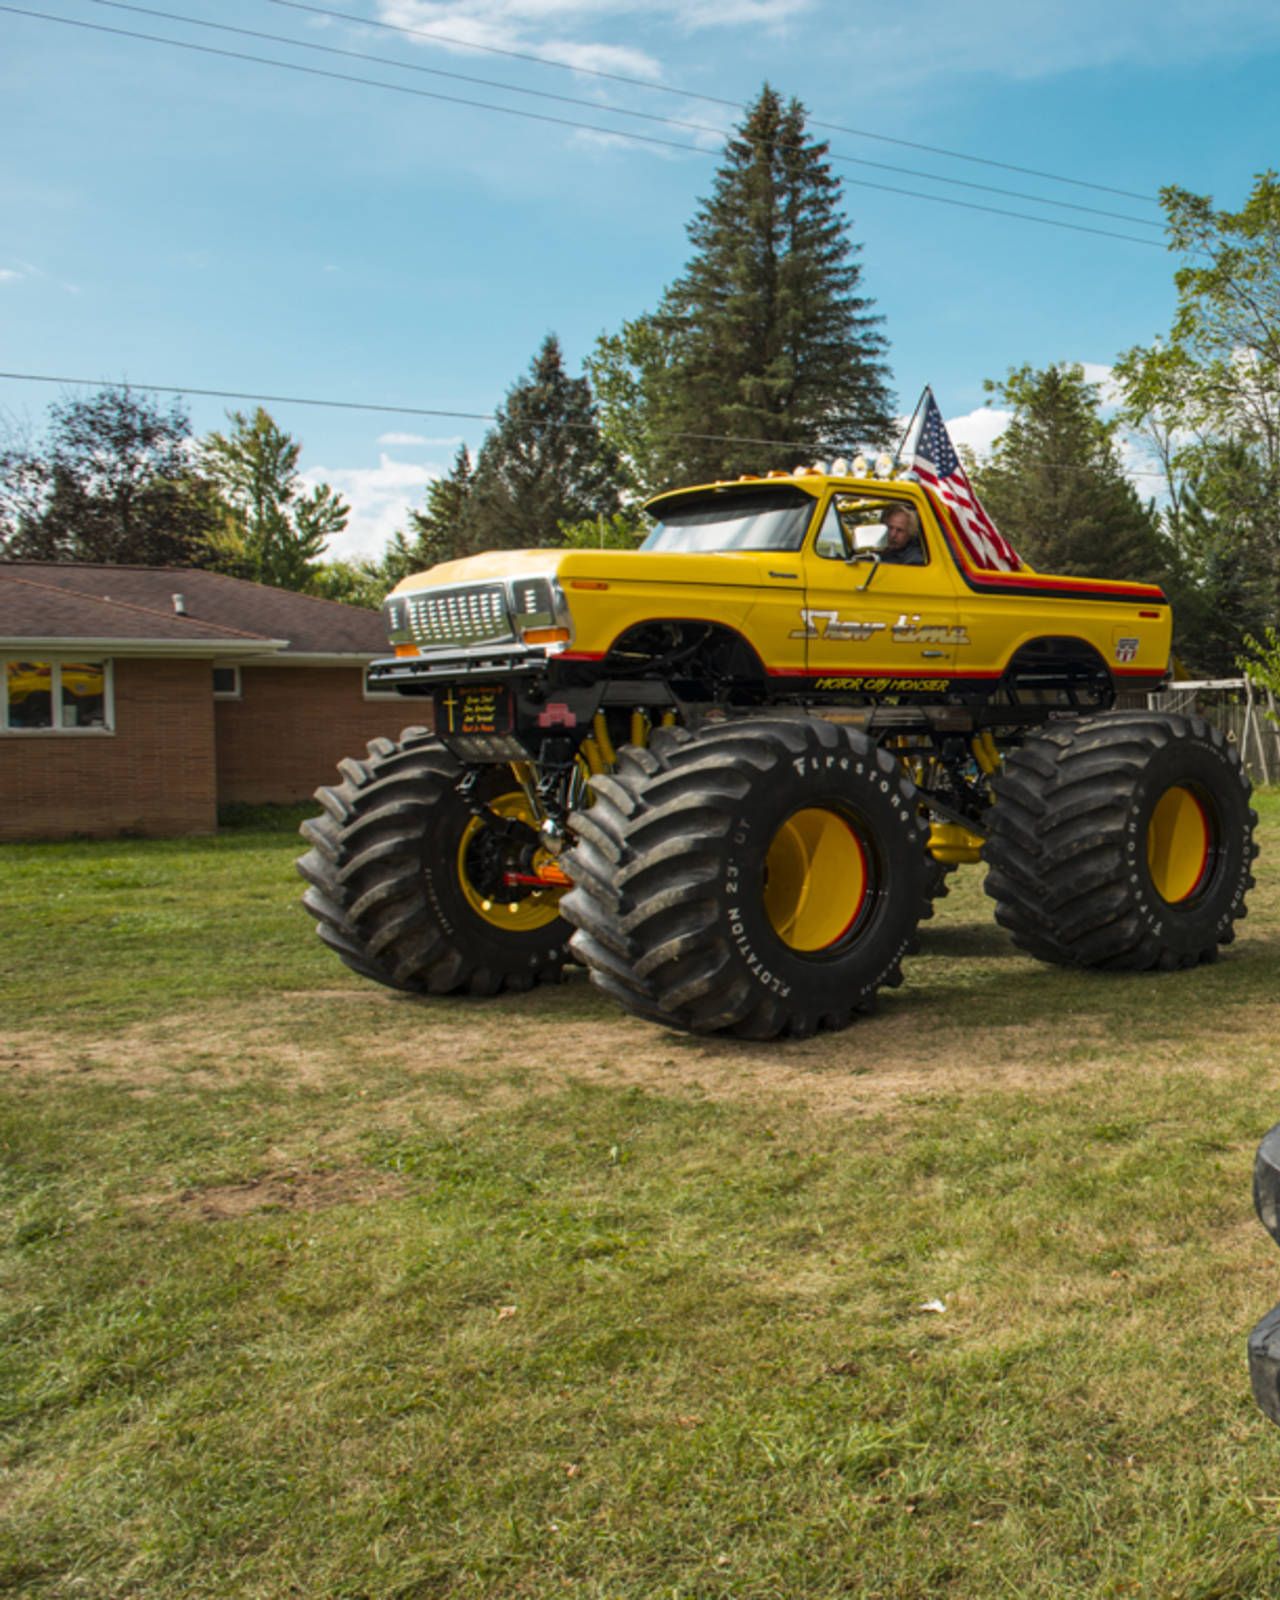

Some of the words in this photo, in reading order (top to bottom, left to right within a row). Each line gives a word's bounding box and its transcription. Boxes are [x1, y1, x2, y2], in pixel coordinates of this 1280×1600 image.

[814, 677, 864, 692] MOTOR
[890, 679, 950, 693] MONSTER
[728, 907, 792, 998] FLOTATION
